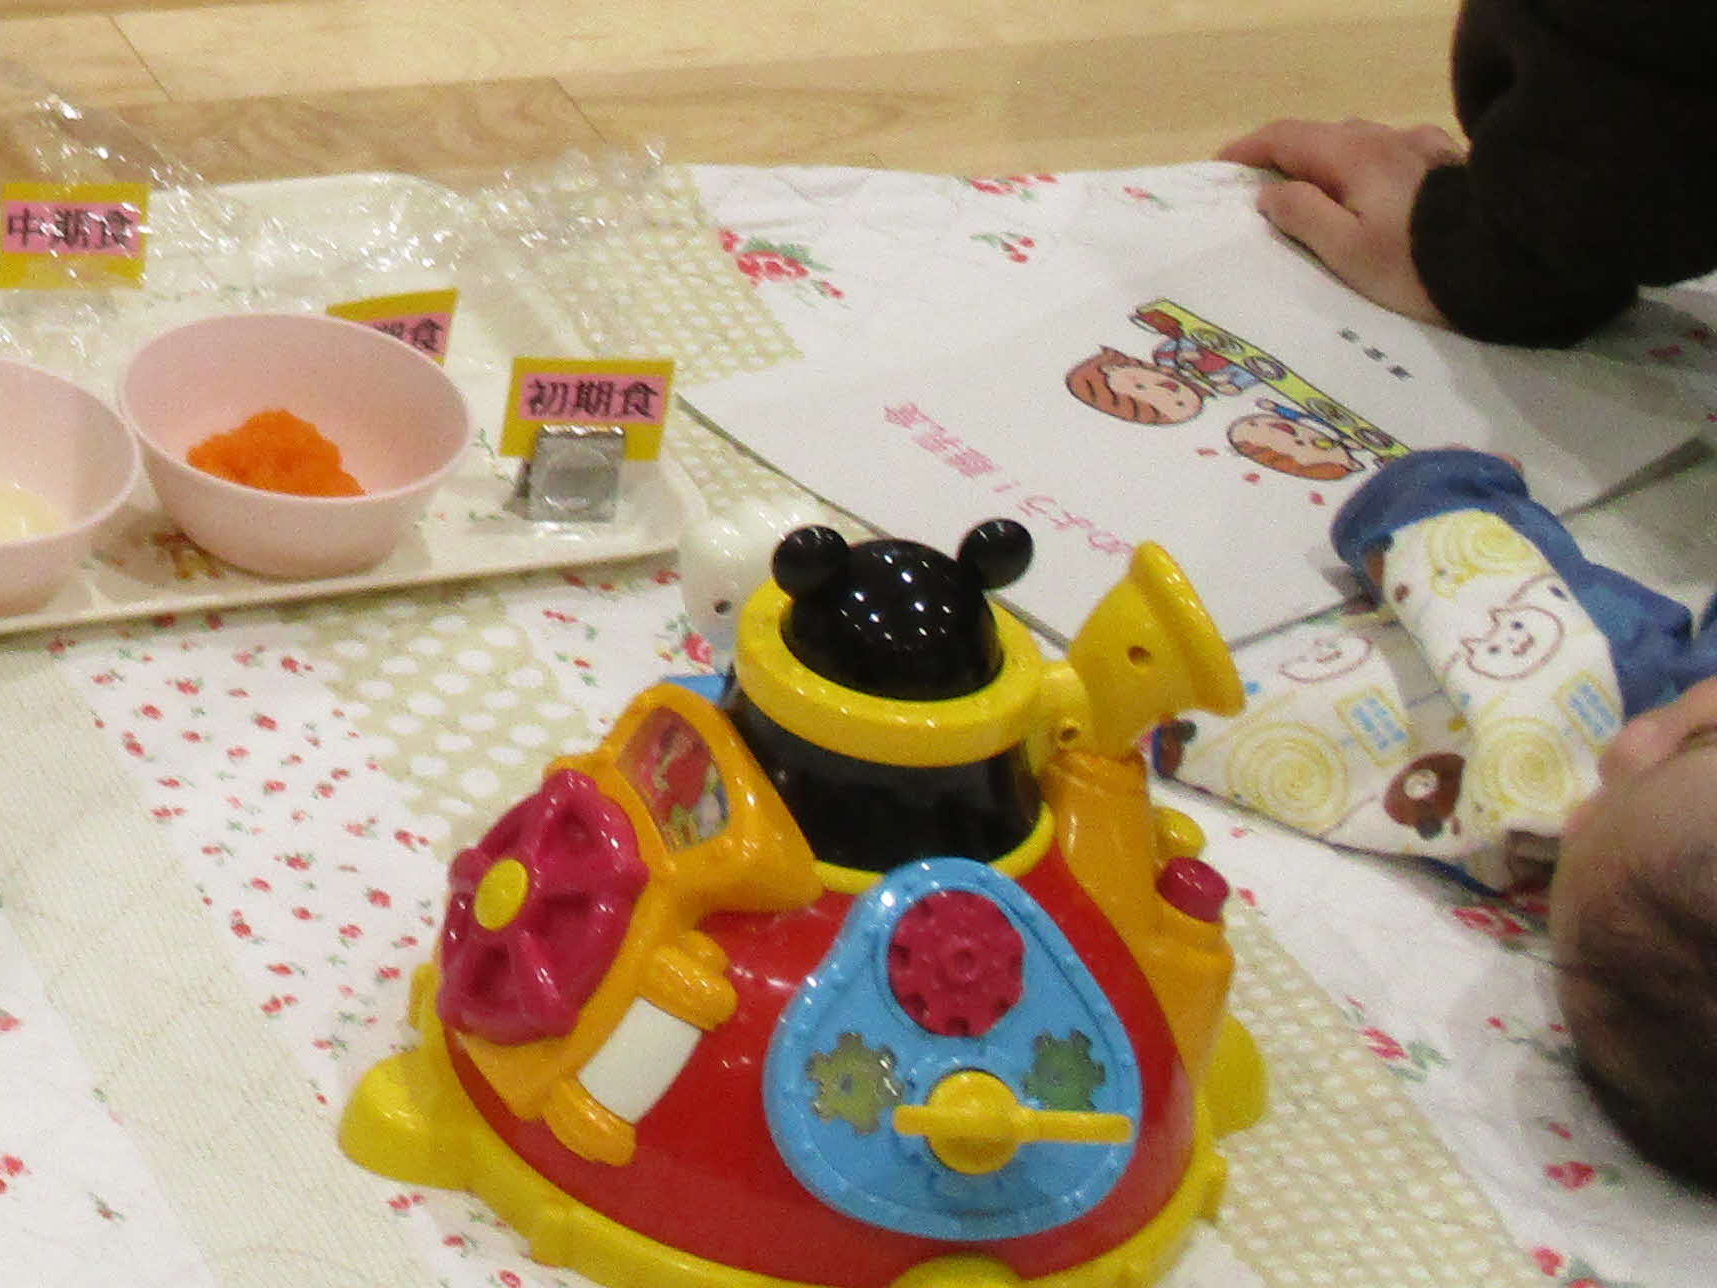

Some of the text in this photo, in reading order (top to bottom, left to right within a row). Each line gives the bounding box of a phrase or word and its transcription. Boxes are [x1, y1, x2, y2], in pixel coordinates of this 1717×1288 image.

[7, 206, 134, 251] 中期食
[528, 378, 659, 419] 初期食
